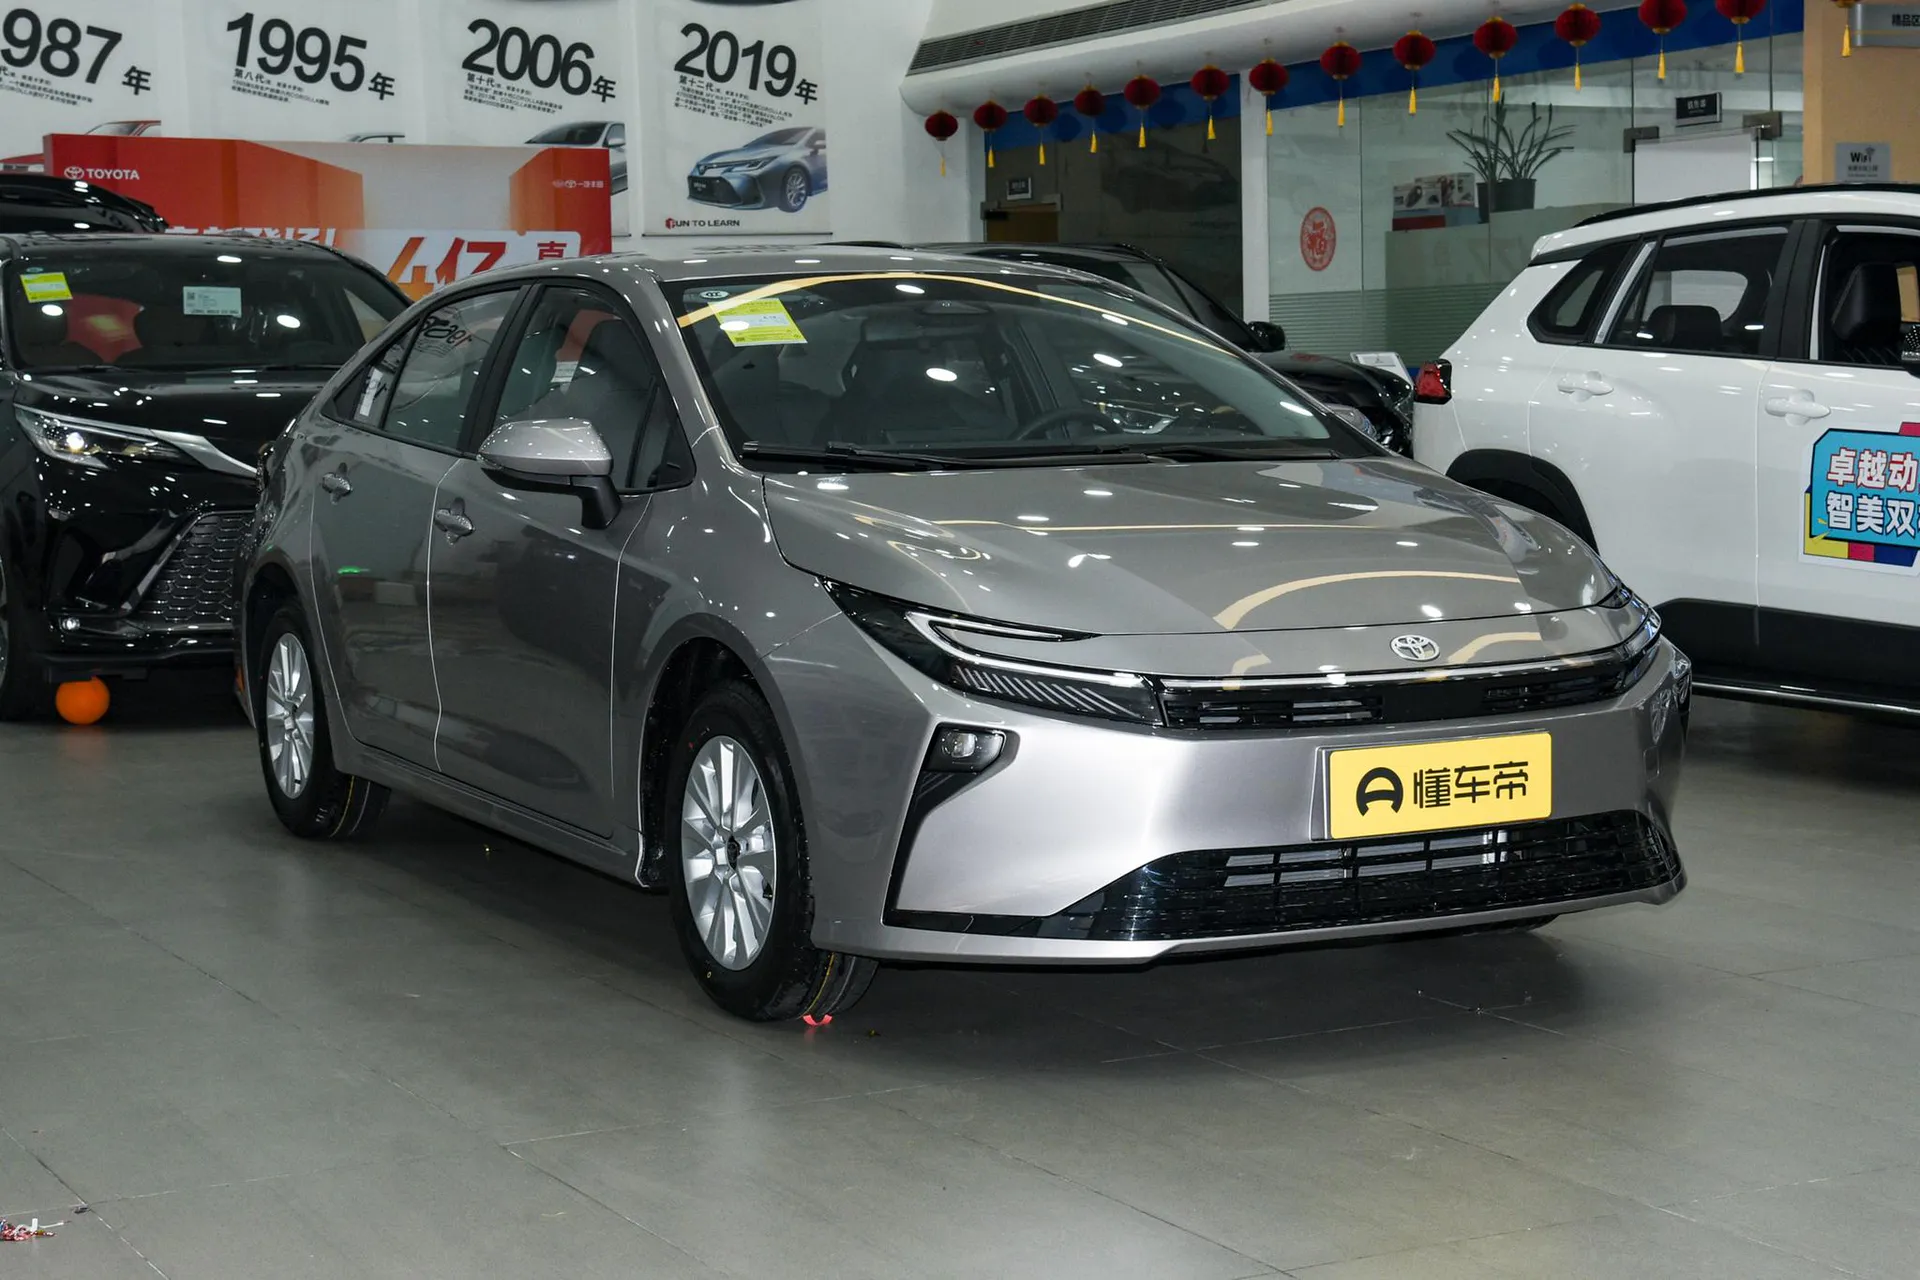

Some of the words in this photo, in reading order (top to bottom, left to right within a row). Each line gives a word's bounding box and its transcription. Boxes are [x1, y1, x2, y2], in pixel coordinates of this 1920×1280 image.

[226, 12, 396, 101] 1995年
[461, 19, 616, 103] 2006年
[674, 23, 819, 106] 2019年
[86, 168, 140, 180] TOYOTA
[692, 219, 707, 227] TO
[708, 219, 741, 227] LEARN
[1825, 490, 1920, 539] 智美双
[1413, 761, 1529, 809] 懂车帝
